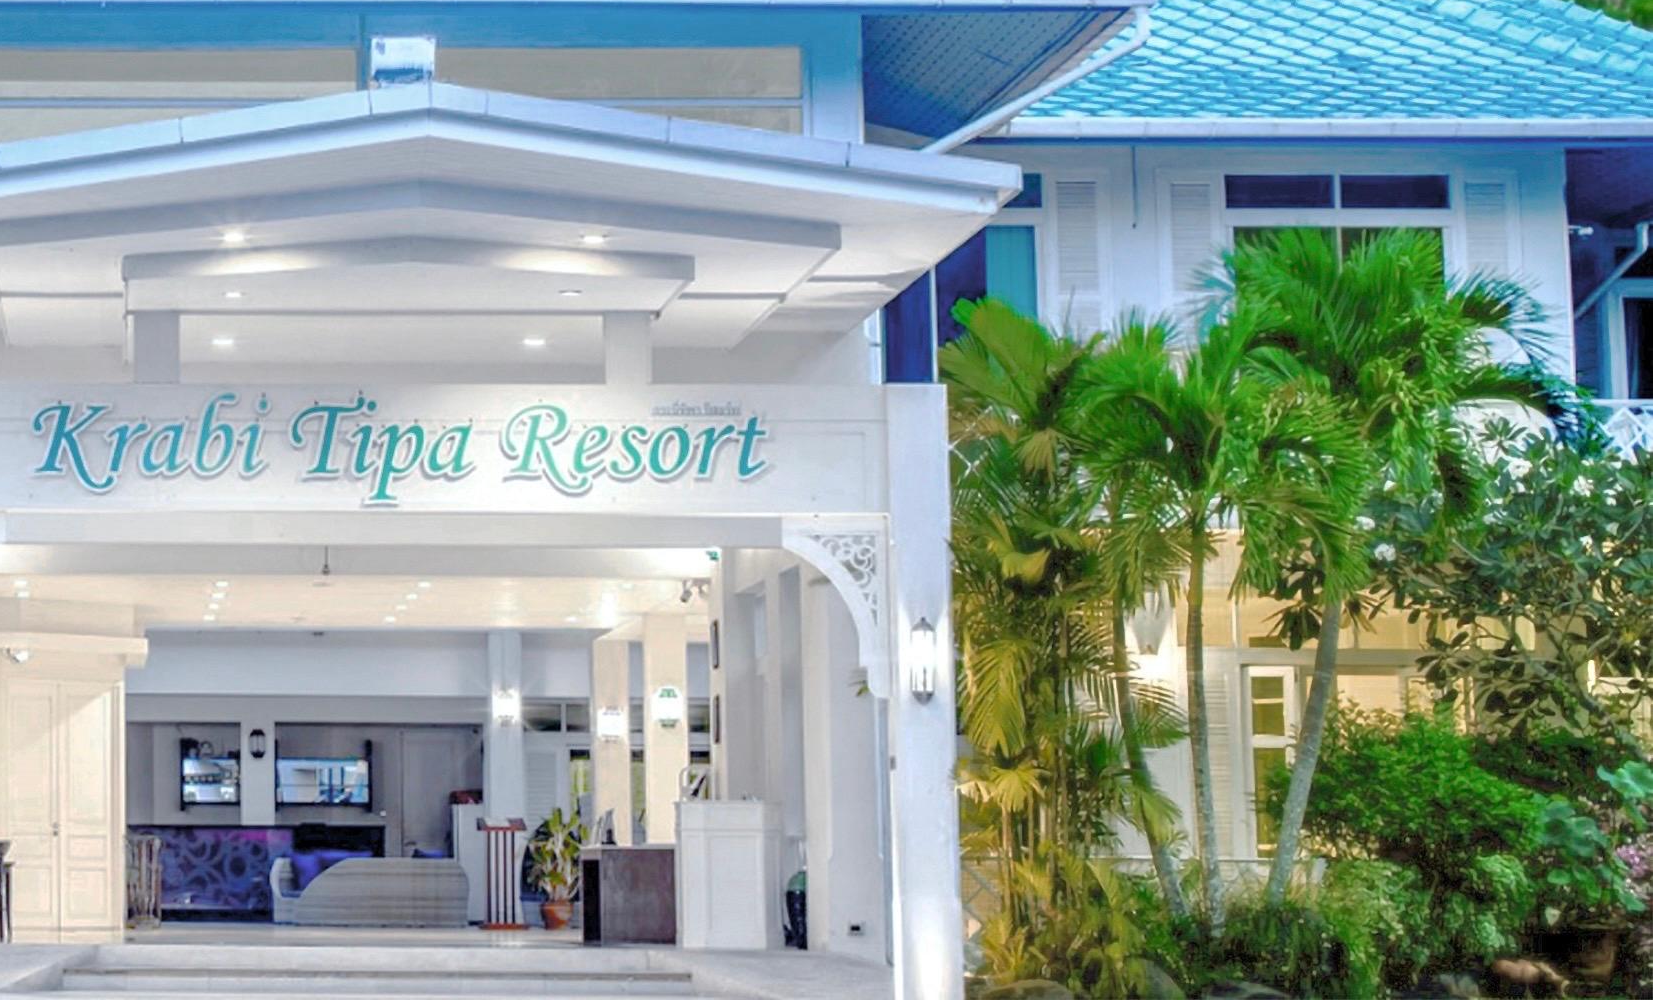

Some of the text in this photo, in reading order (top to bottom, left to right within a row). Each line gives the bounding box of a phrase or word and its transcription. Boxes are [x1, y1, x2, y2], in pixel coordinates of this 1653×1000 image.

[32, 393, 770, 503] Krabi Tipa Resort
